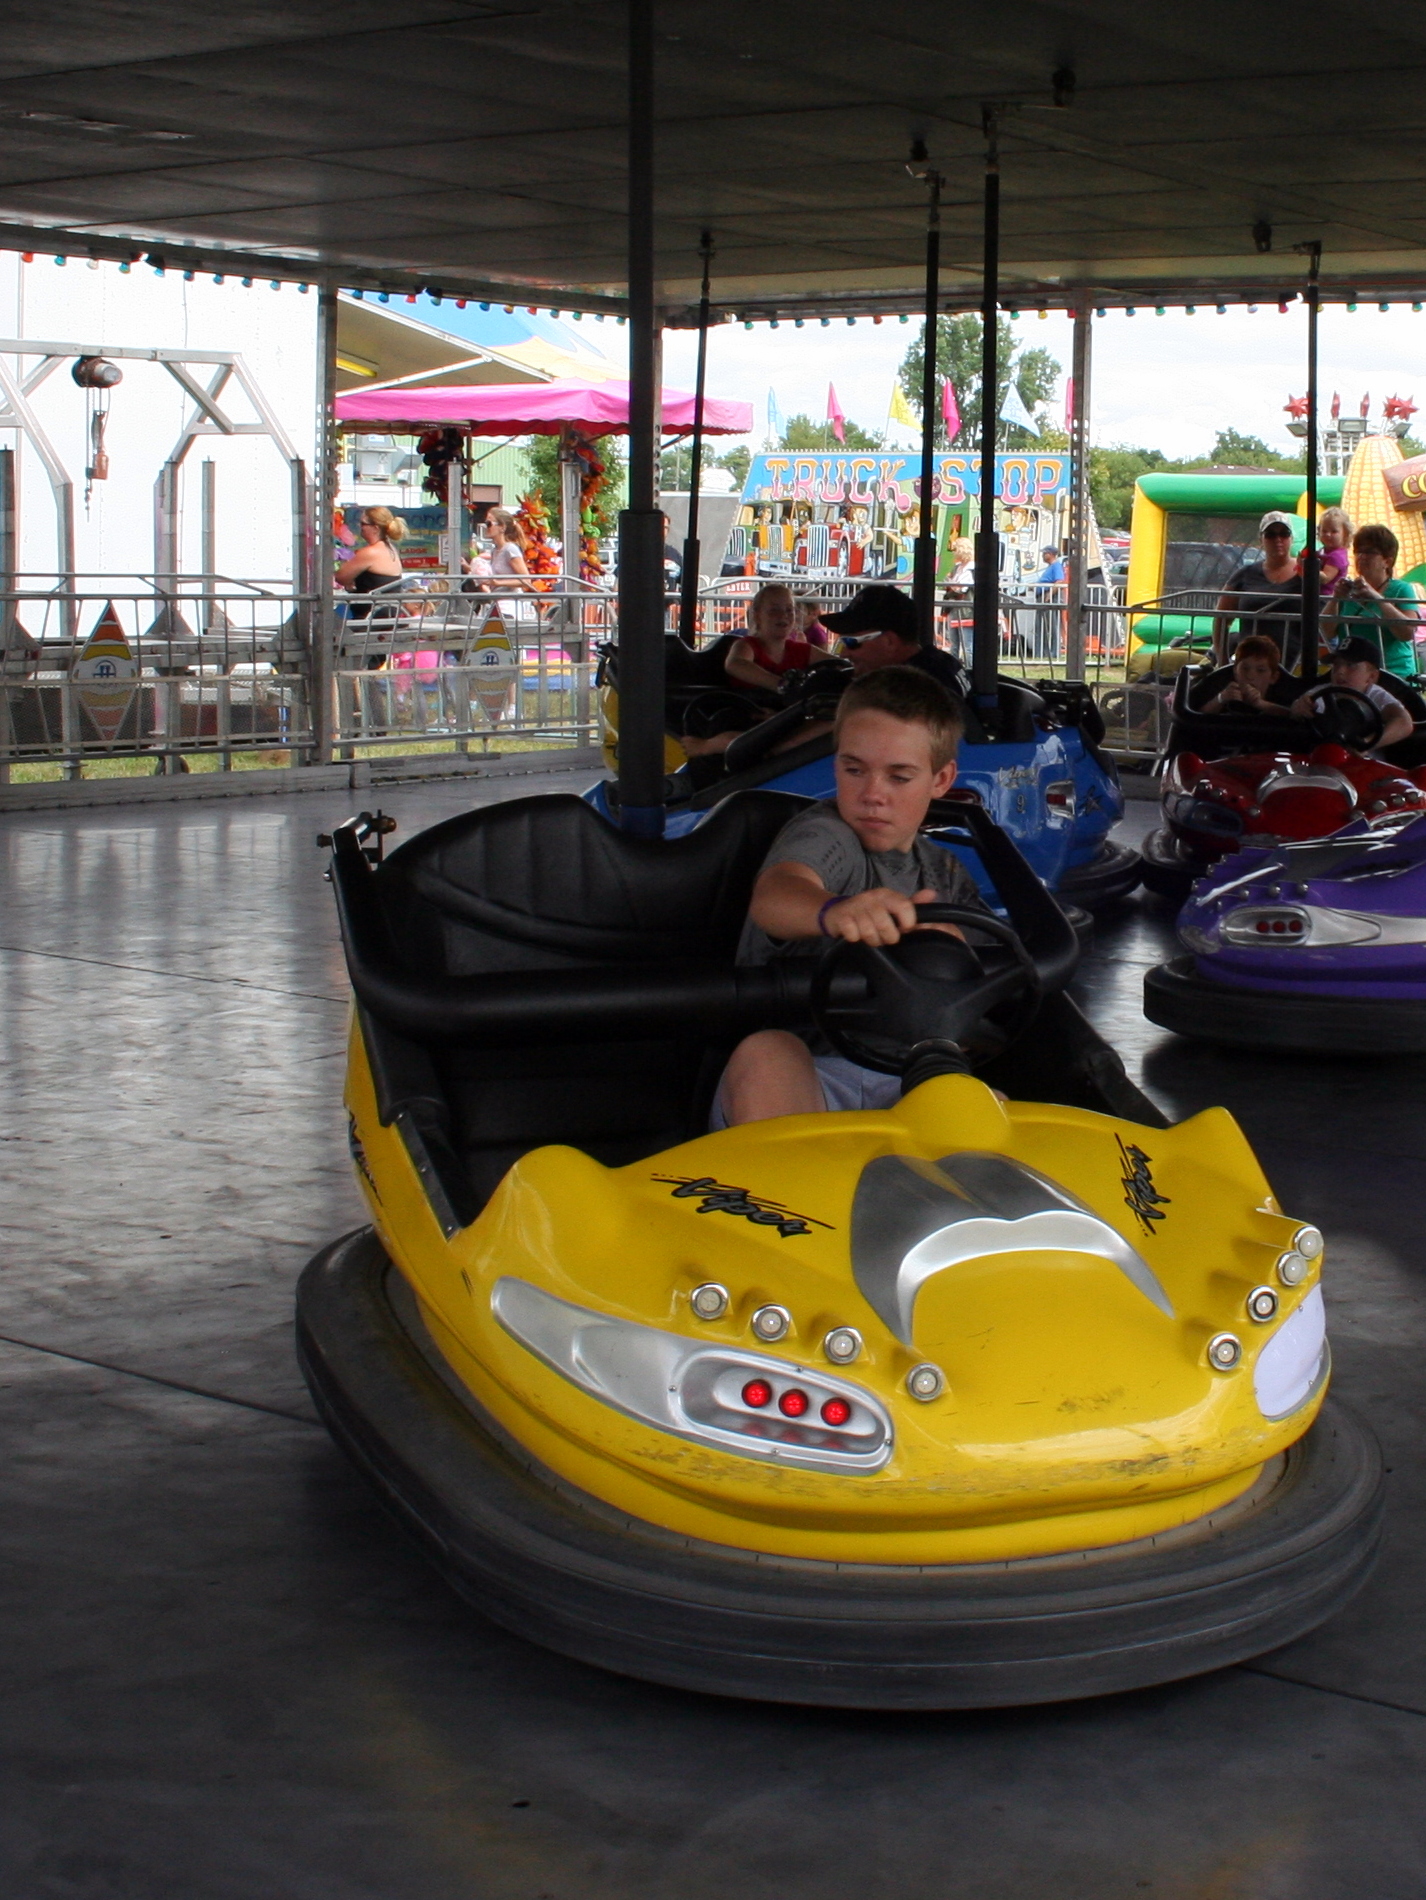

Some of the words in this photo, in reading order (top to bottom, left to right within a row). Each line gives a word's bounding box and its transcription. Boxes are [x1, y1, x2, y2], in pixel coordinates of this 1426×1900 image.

[765, 458, 912, 513] TRUCK
[665, 1176, 815, 1238] Viper
[1119, 1140, 1172, 1226] Viper
